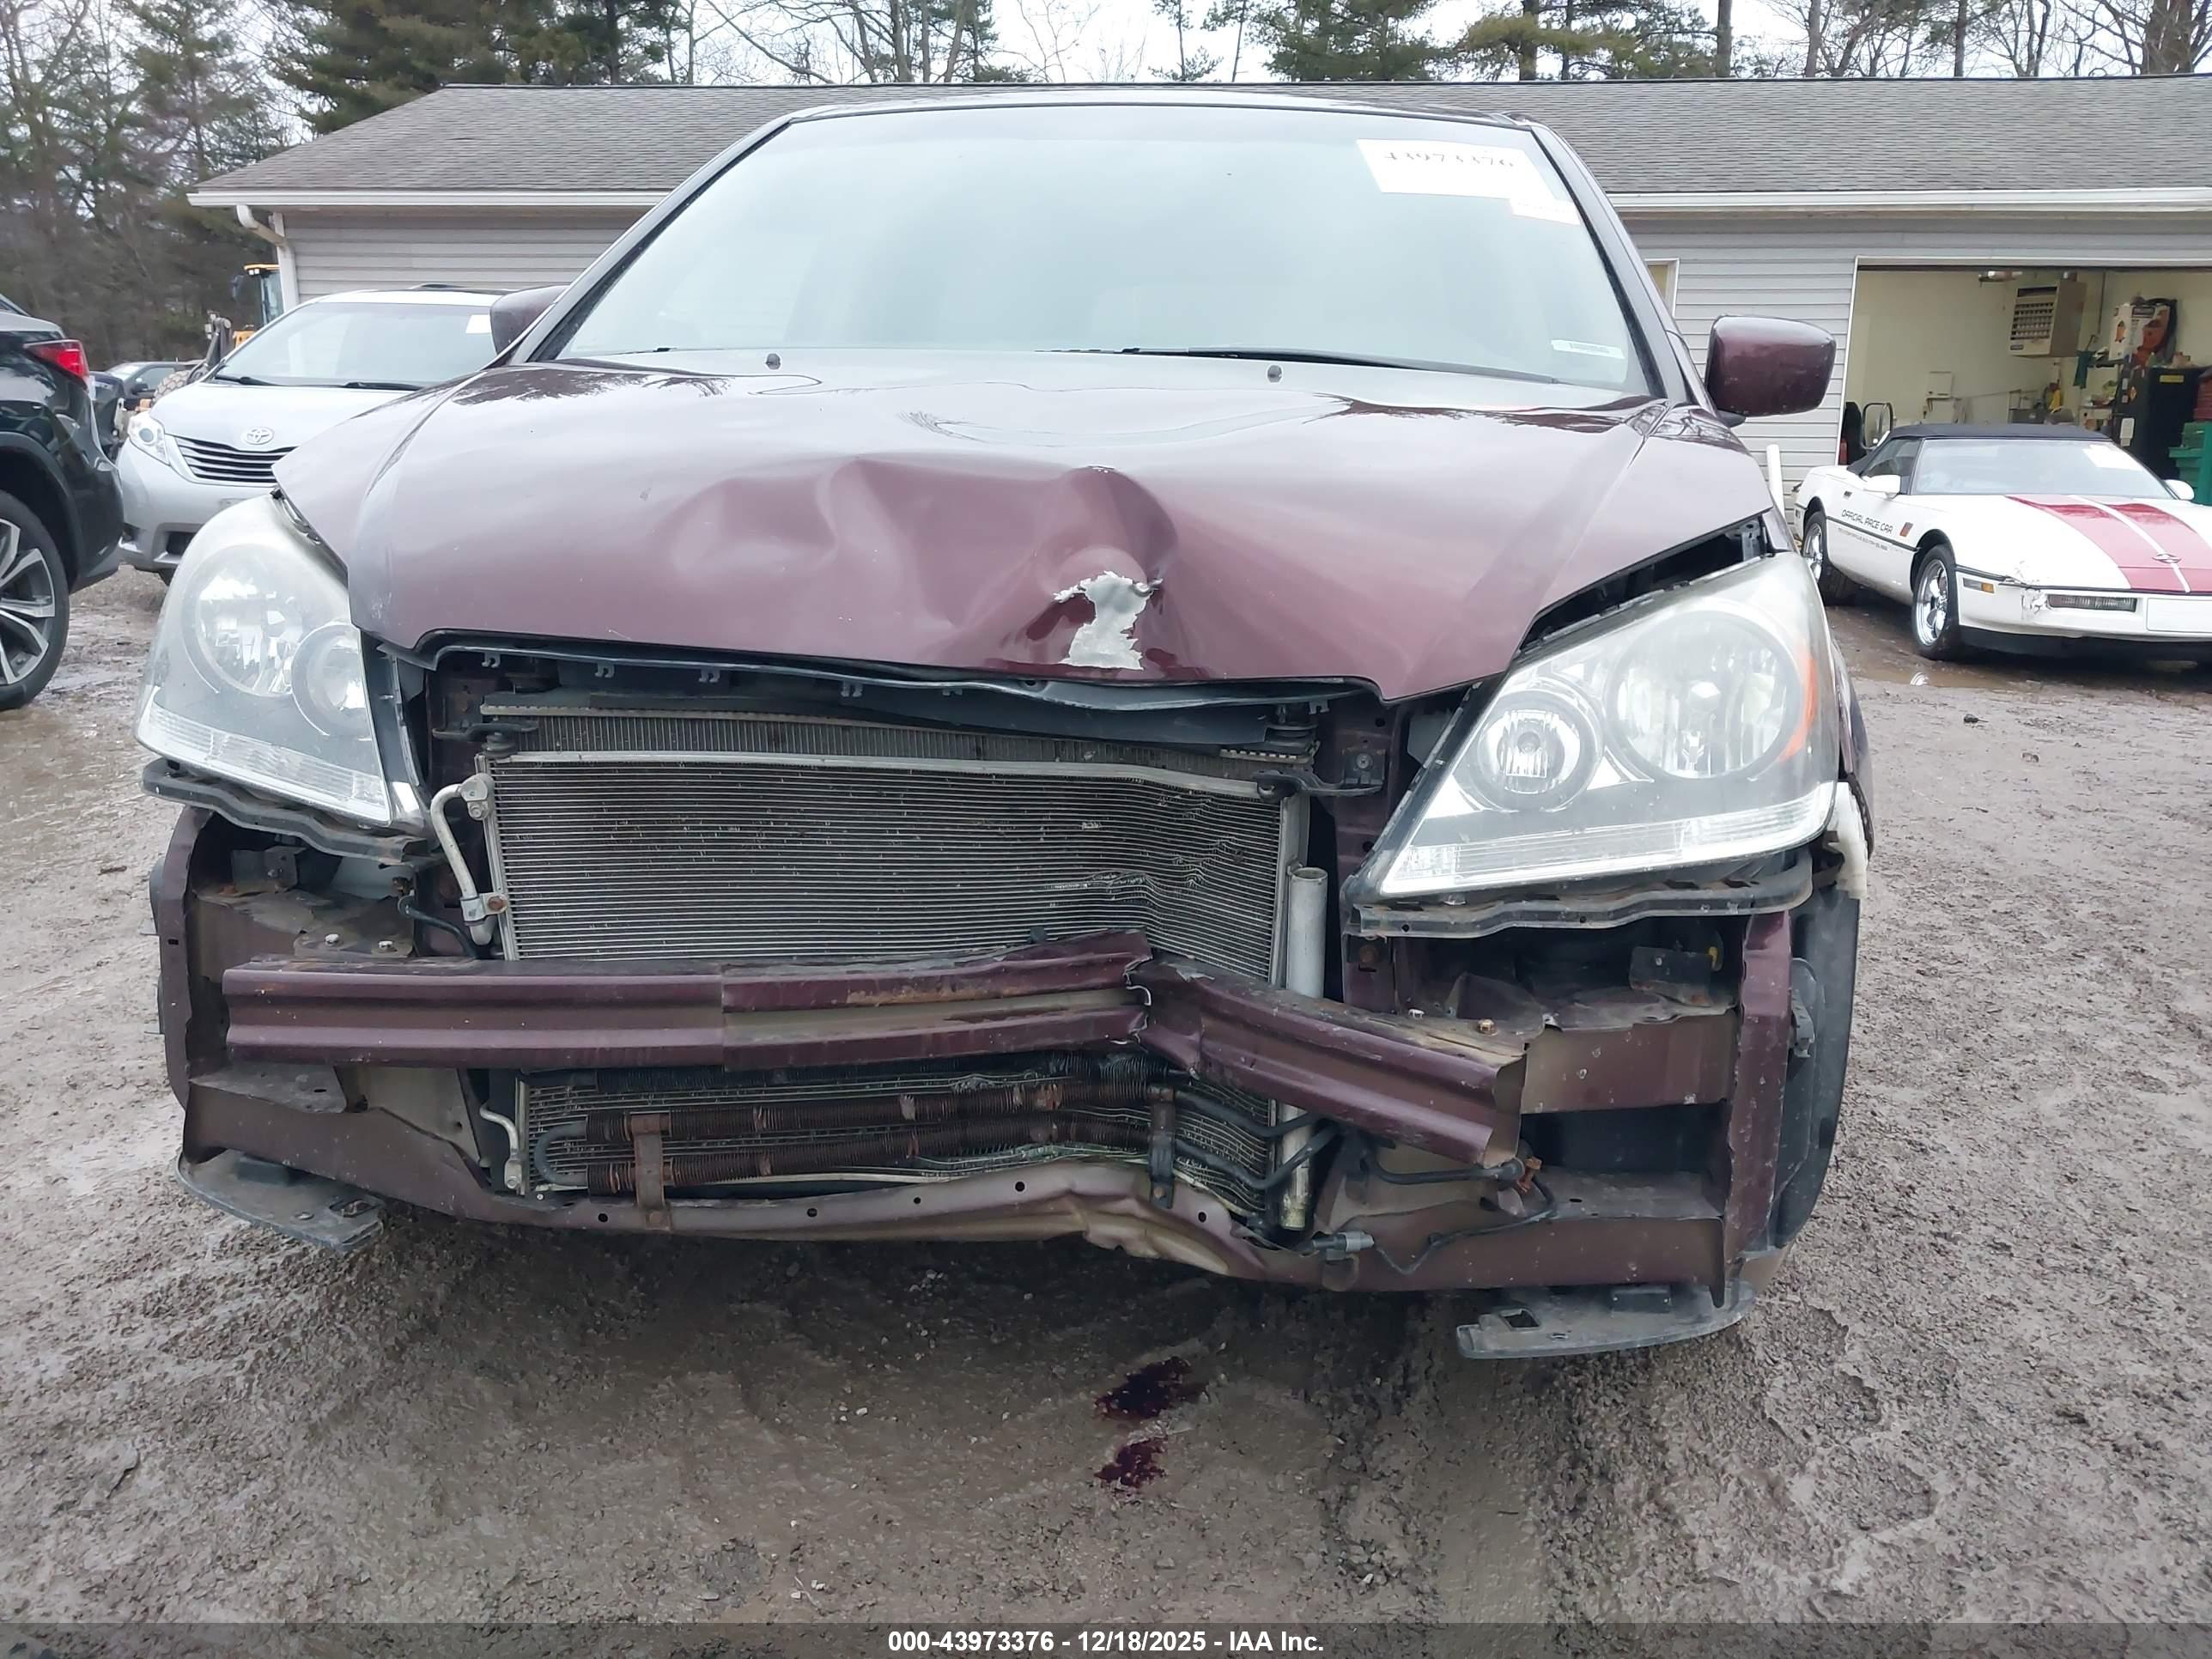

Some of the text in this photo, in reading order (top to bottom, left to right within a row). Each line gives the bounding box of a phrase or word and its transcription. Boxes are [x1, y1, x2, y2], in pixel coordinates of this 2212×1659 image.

[1841, 509, 1893, 534] OFFICIAL PACE CAR
